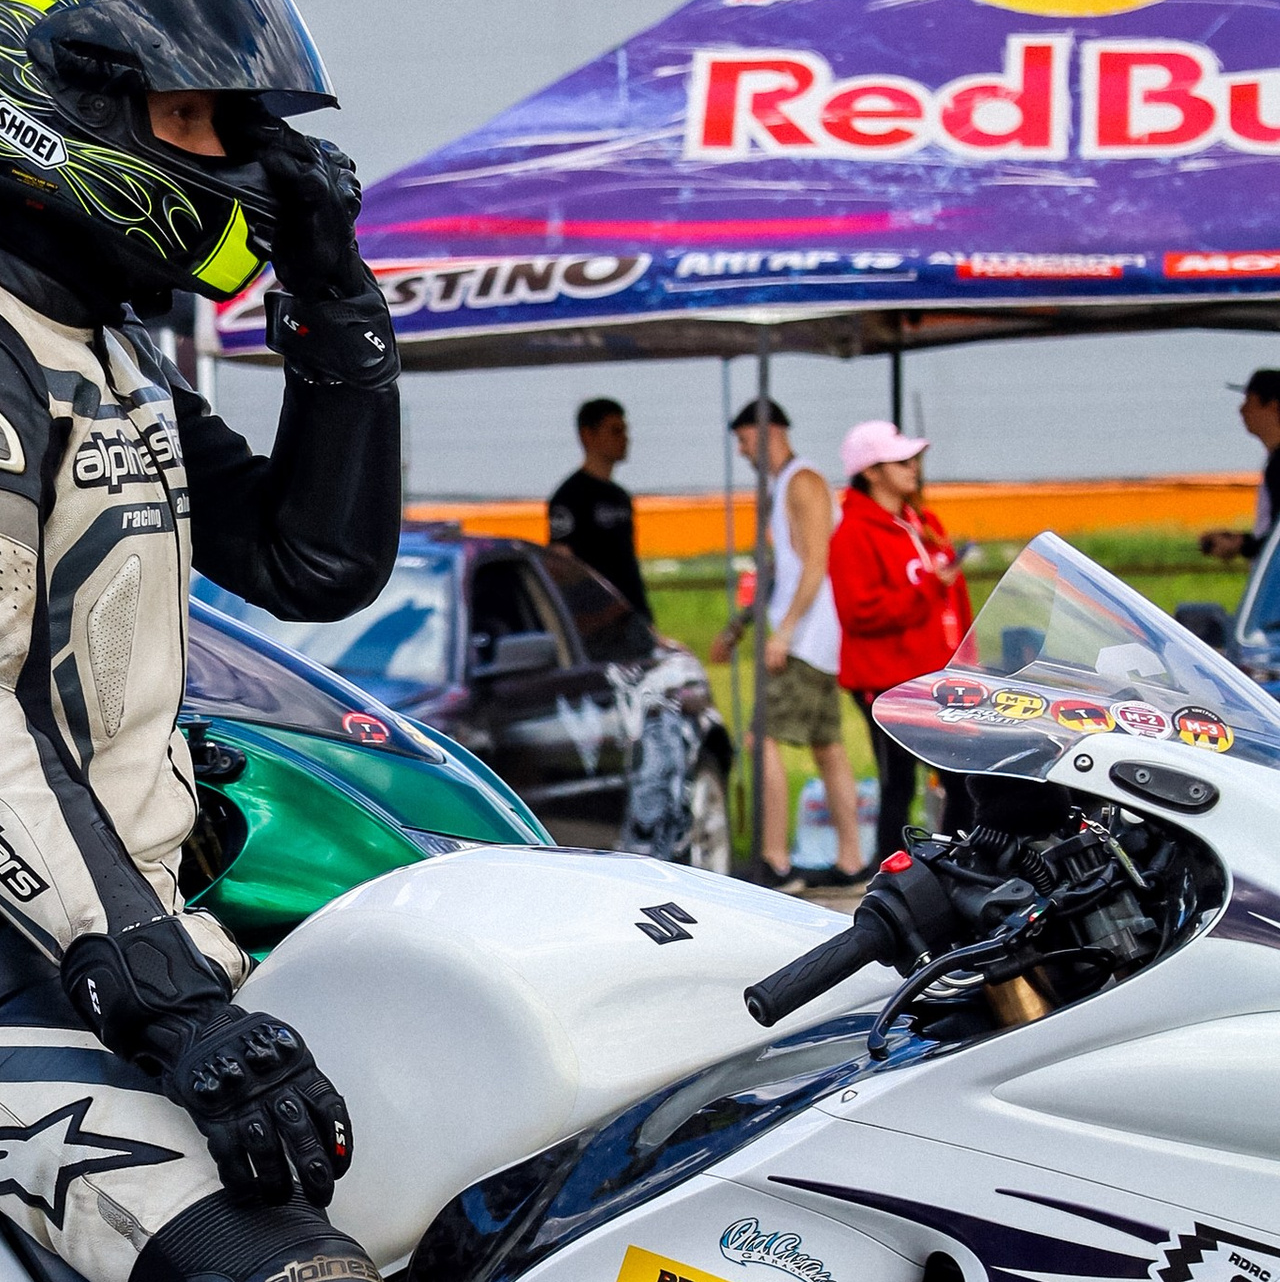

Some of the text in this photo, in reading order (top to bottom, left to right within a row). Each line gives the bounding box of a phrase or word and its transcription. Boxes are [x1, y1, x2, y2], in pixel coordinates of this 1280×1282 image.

[688, 35, 1070, 157] Red
[363, 330, 387, 353] LS2
[121, 505, 162, 529] racing
[1005, 695, 1035, 705] M-1
[1125, 711, 1158, 725] M-2
[1185, 720, 1219, 736] M-3
[1228, 1251, 1271, 1282] RDRC
